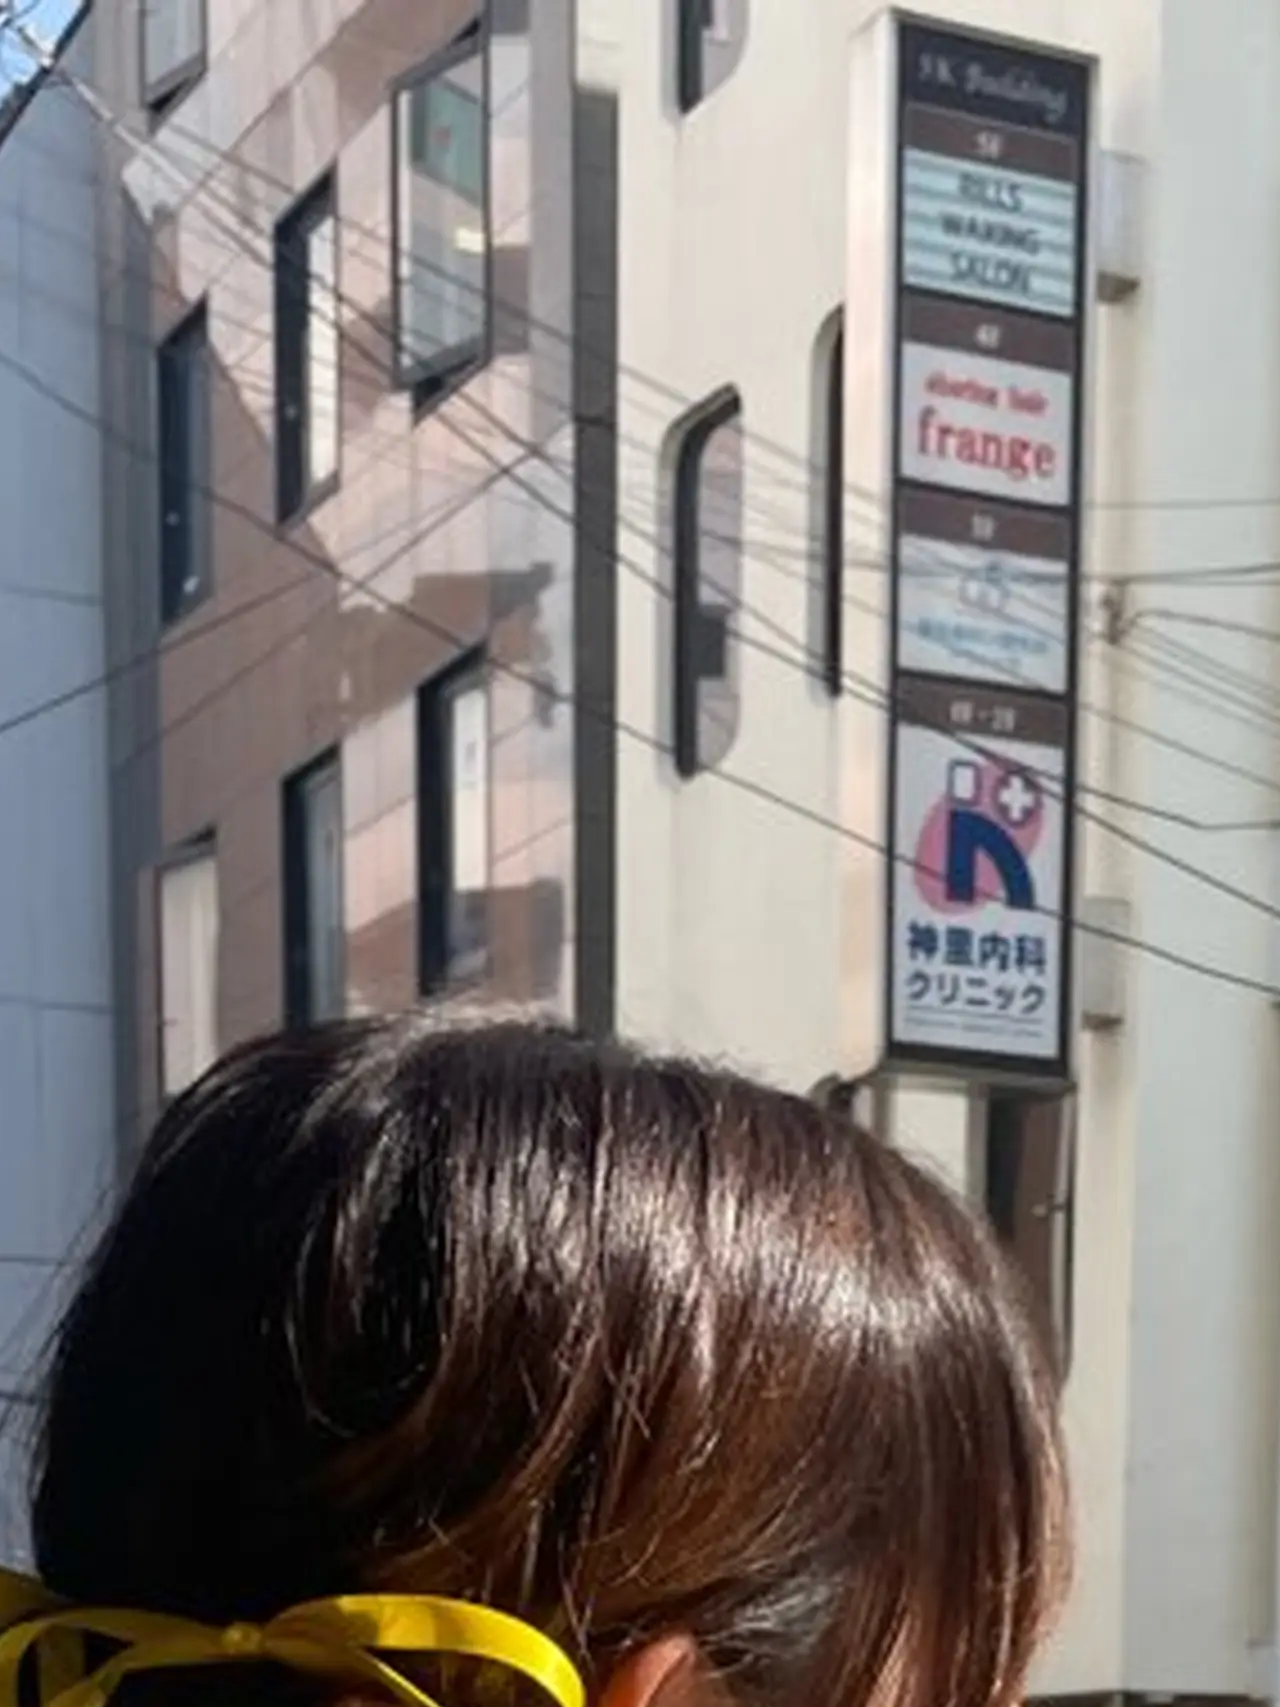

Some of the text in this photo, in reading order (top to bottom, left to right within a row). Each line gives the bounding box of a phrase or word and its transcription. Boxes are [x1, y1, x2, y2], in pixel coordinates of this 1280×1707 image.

[941, 213, 1040, 257] WAXING
[951, 251, 1031, 295] SALON
[918, 404, 1056, 483] frange
[904, 970, 1047, 1014] クリニック
